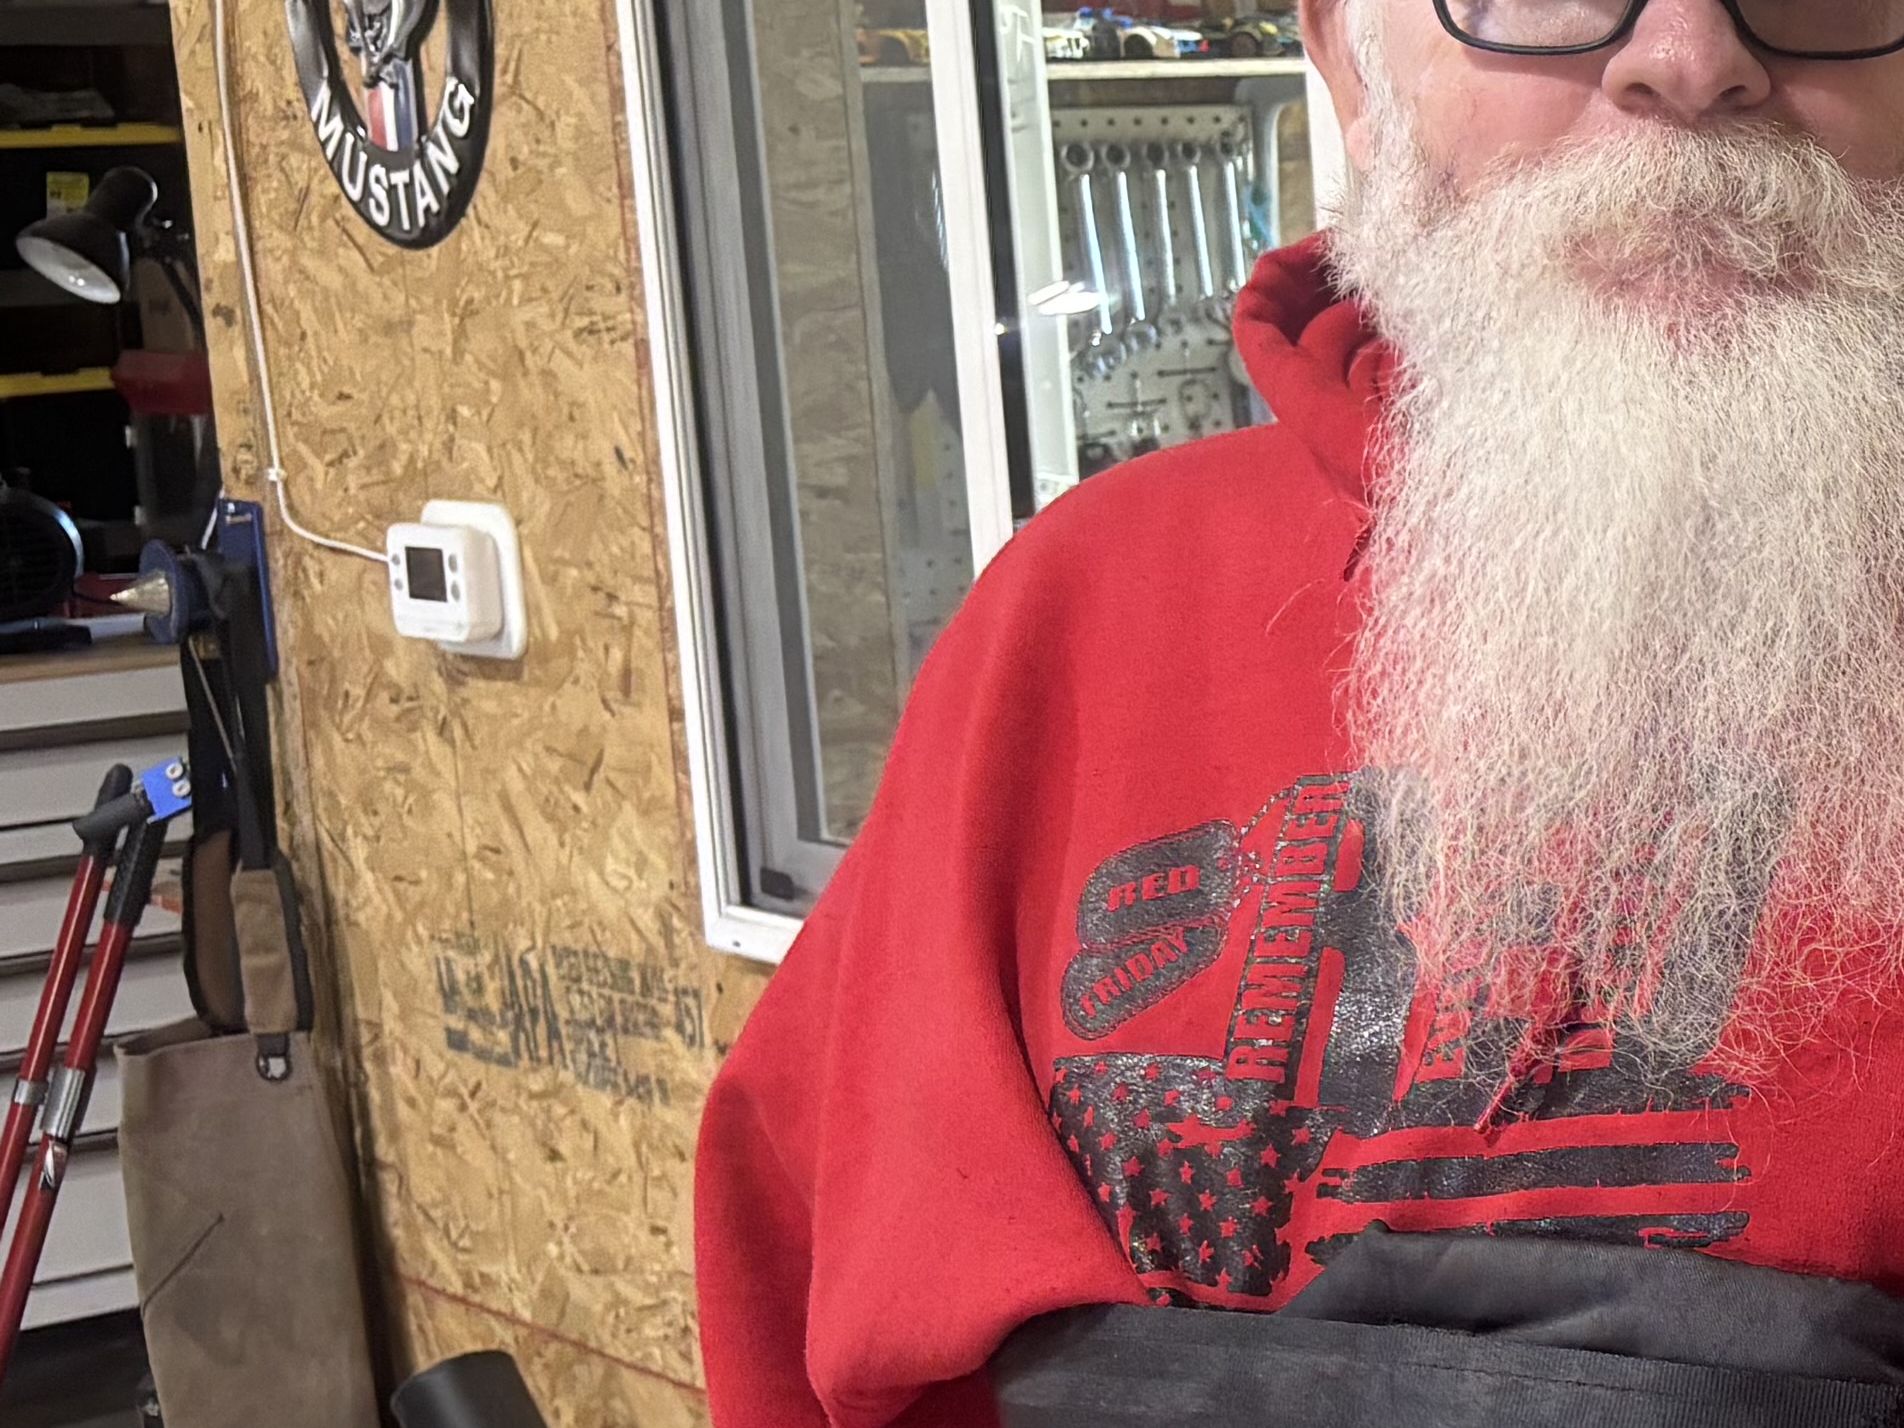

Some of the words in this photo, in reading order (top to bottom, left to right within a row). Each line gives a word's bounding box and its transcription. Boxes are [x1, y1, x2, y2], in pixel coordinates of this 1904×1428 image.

[309, 77, 475, 231] MUSTANG
[1105, 864, 1200, 913] RED
[1225, 775, 1350, 1081] REMEMBER
[1078, 928, 1192, 1021] FRIDAY
